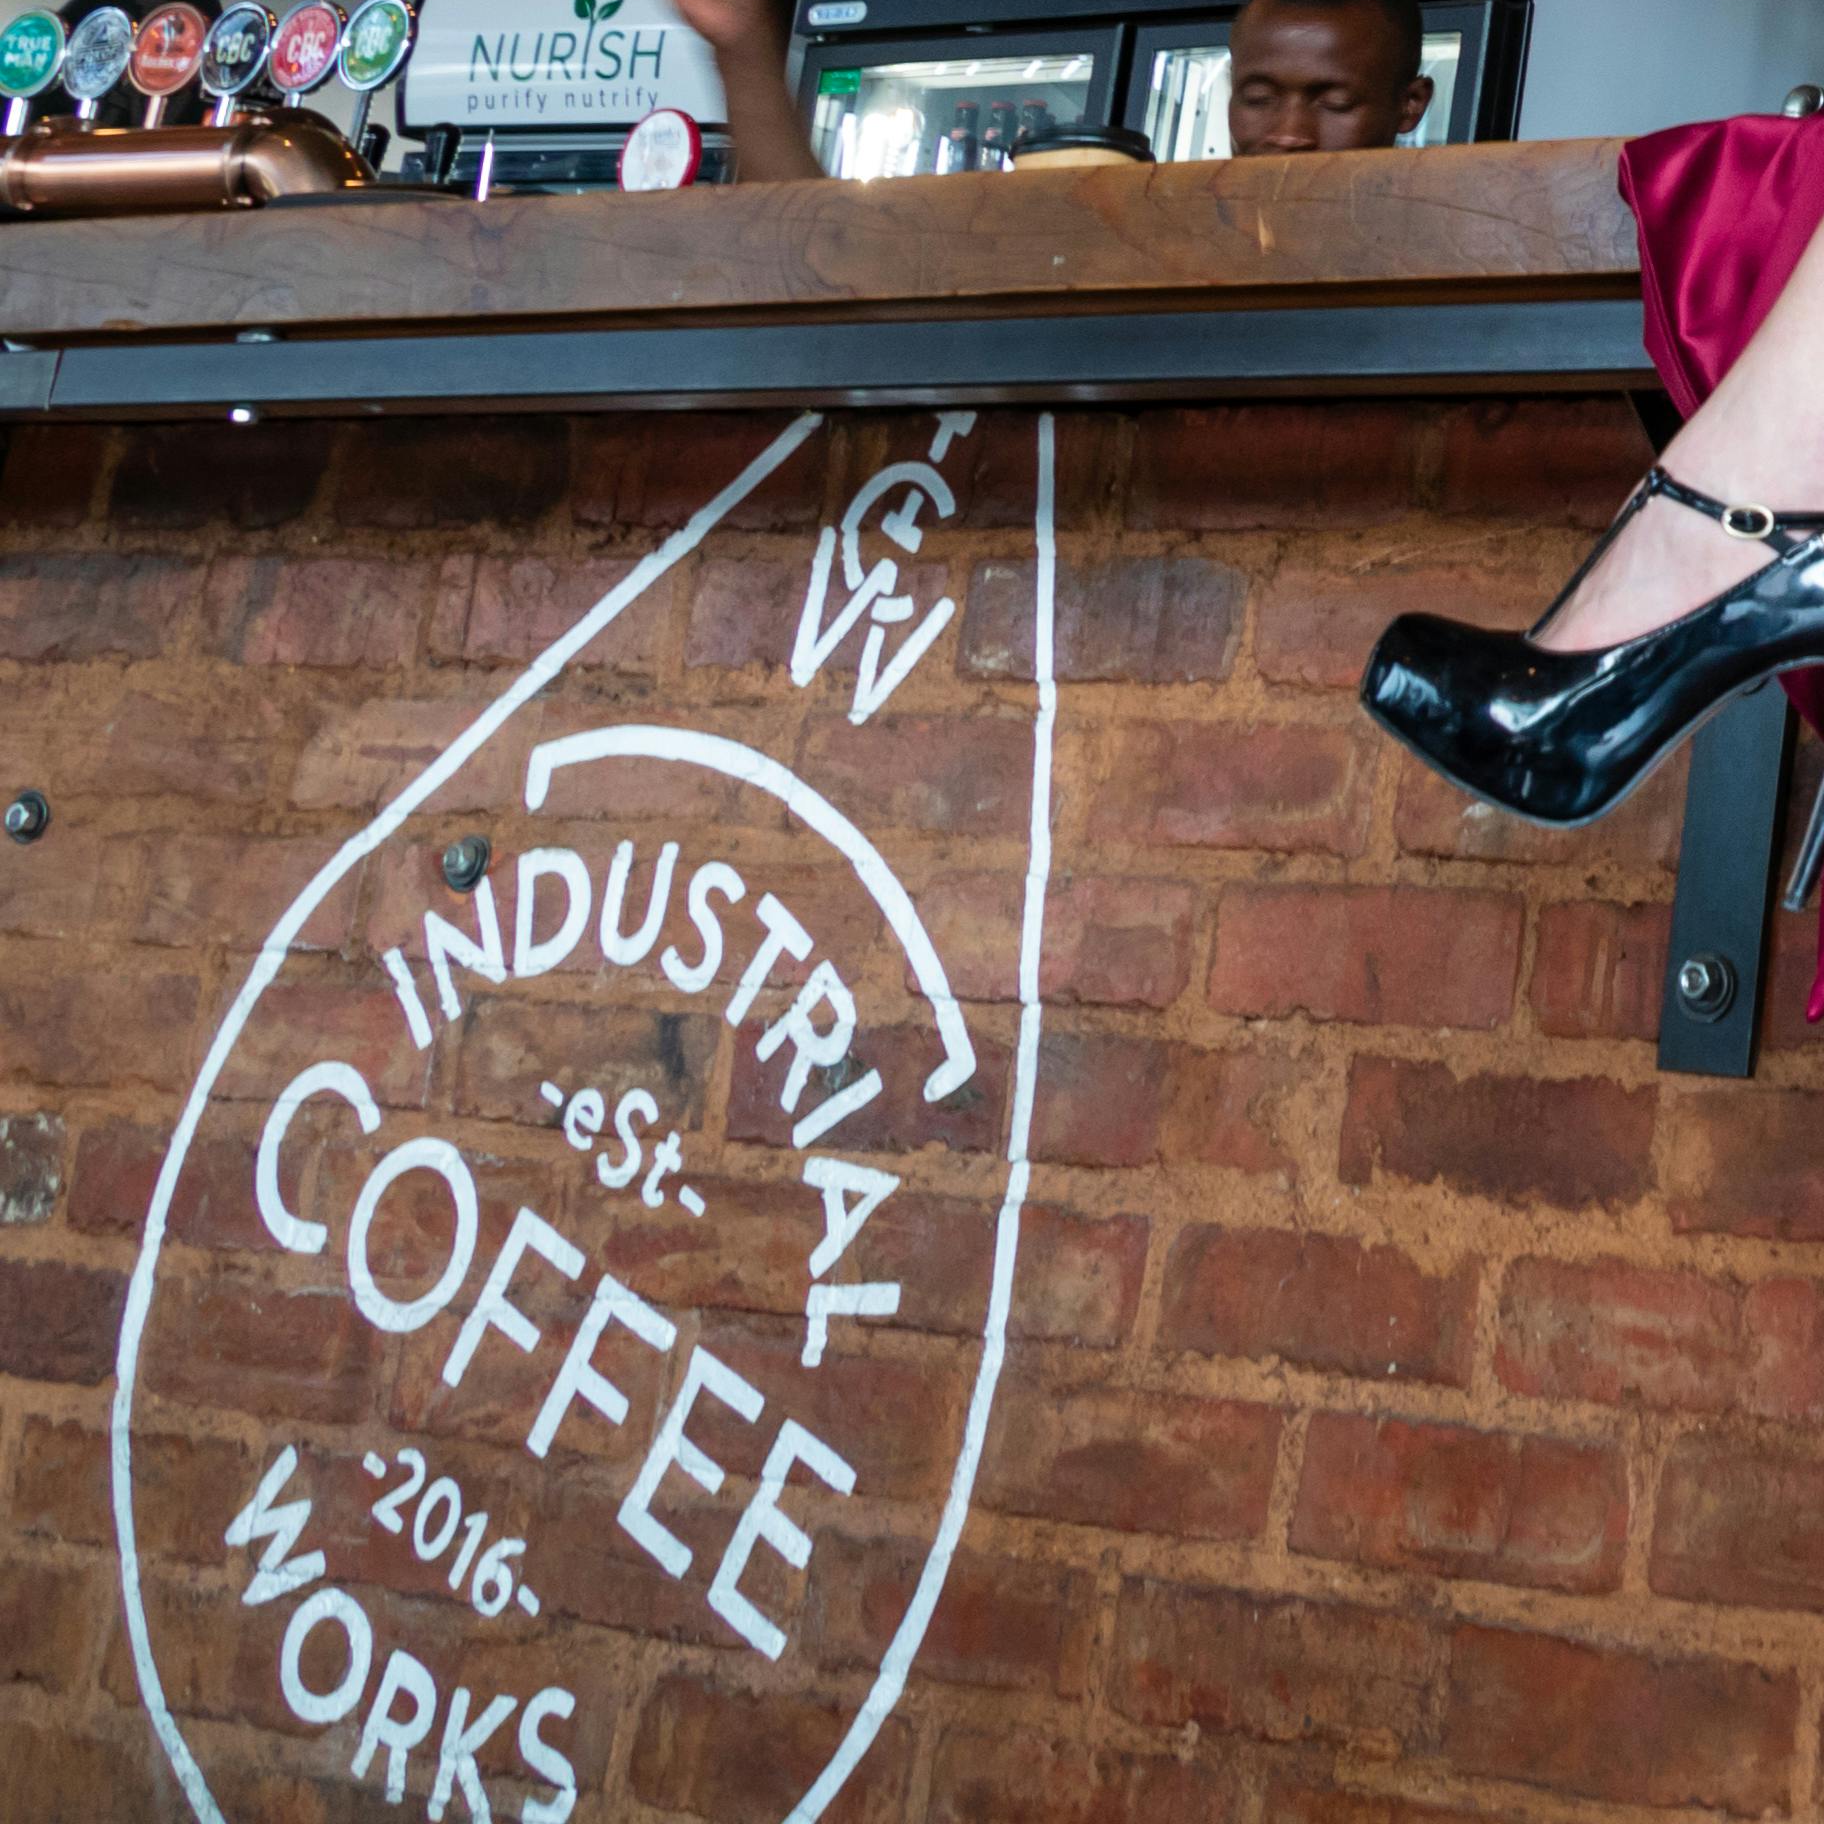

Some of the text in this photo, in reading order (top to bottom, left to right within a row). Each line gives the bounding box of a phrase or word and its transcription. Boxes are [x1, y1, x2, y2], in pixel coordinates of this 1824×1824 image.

[4, 35, 52, 51] TRUE
[215, 31, 255, 65] CBC
[287, 31, 326, 65] CBC
[469, 30, 666, 82] NURISH
[467, 86, 660, 114] purify nutrify
[382, 839, 901, 1368] INDUSTRIAL
[256, 1061, 857, 1662] COFFEE
[224, 1444, 578, 1824] WORKS
